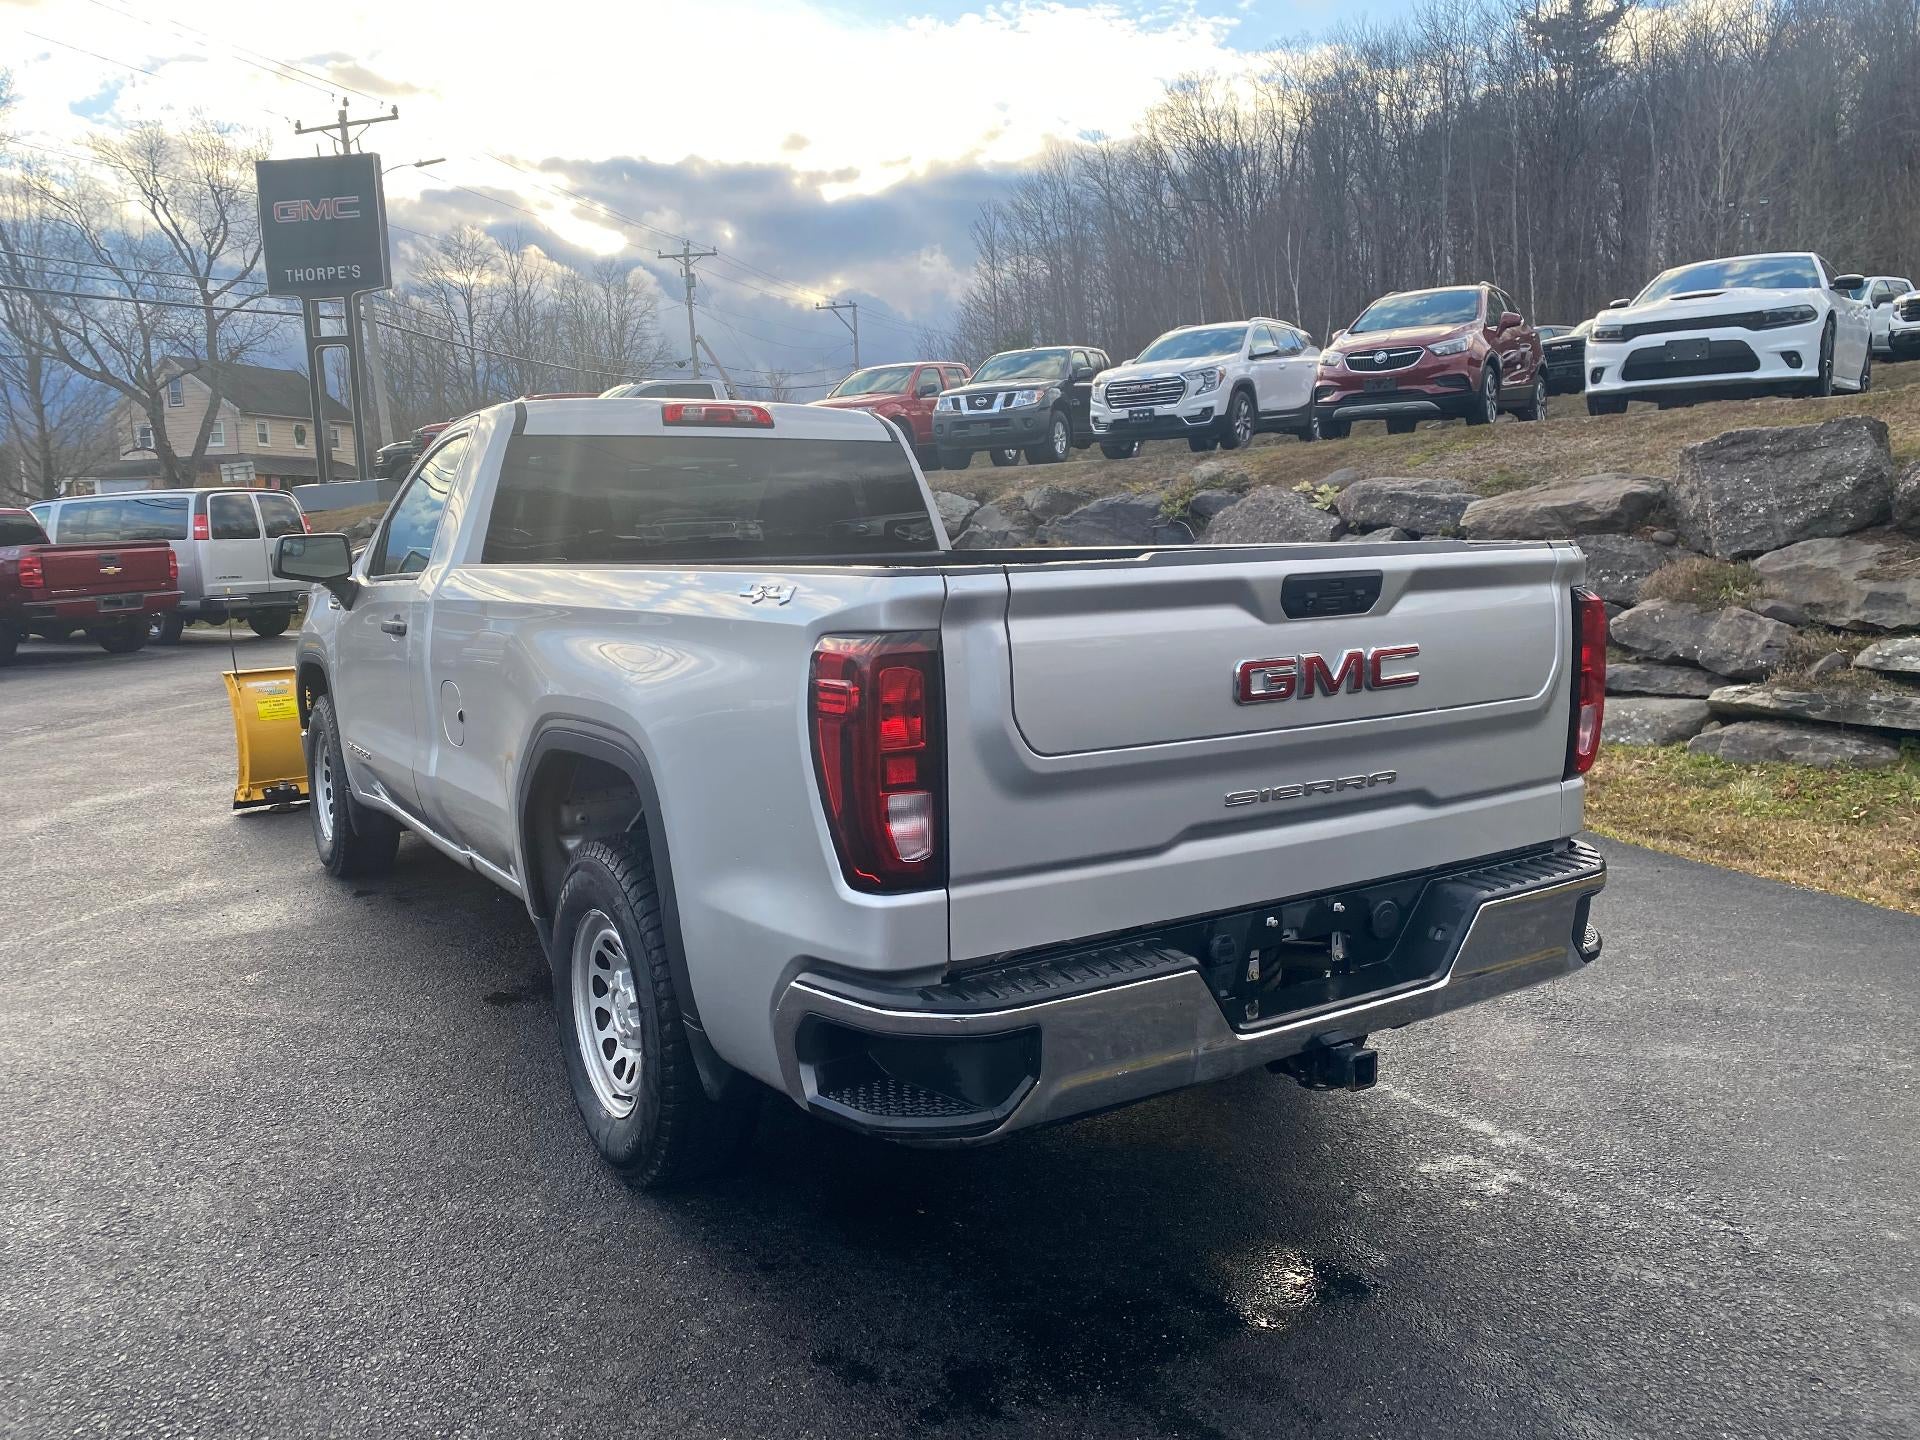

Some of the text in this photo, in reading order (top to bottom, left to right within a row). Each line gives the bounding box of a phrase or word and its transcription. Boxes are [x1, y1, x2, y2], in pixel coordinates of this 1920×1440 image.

[273, 195, 360, 223] GMC
[285, 264, 361, 283] THORPE'S
[1233, 643, 1420, 706] GMC
[1224, 769, 1397, 807] SIERRA
